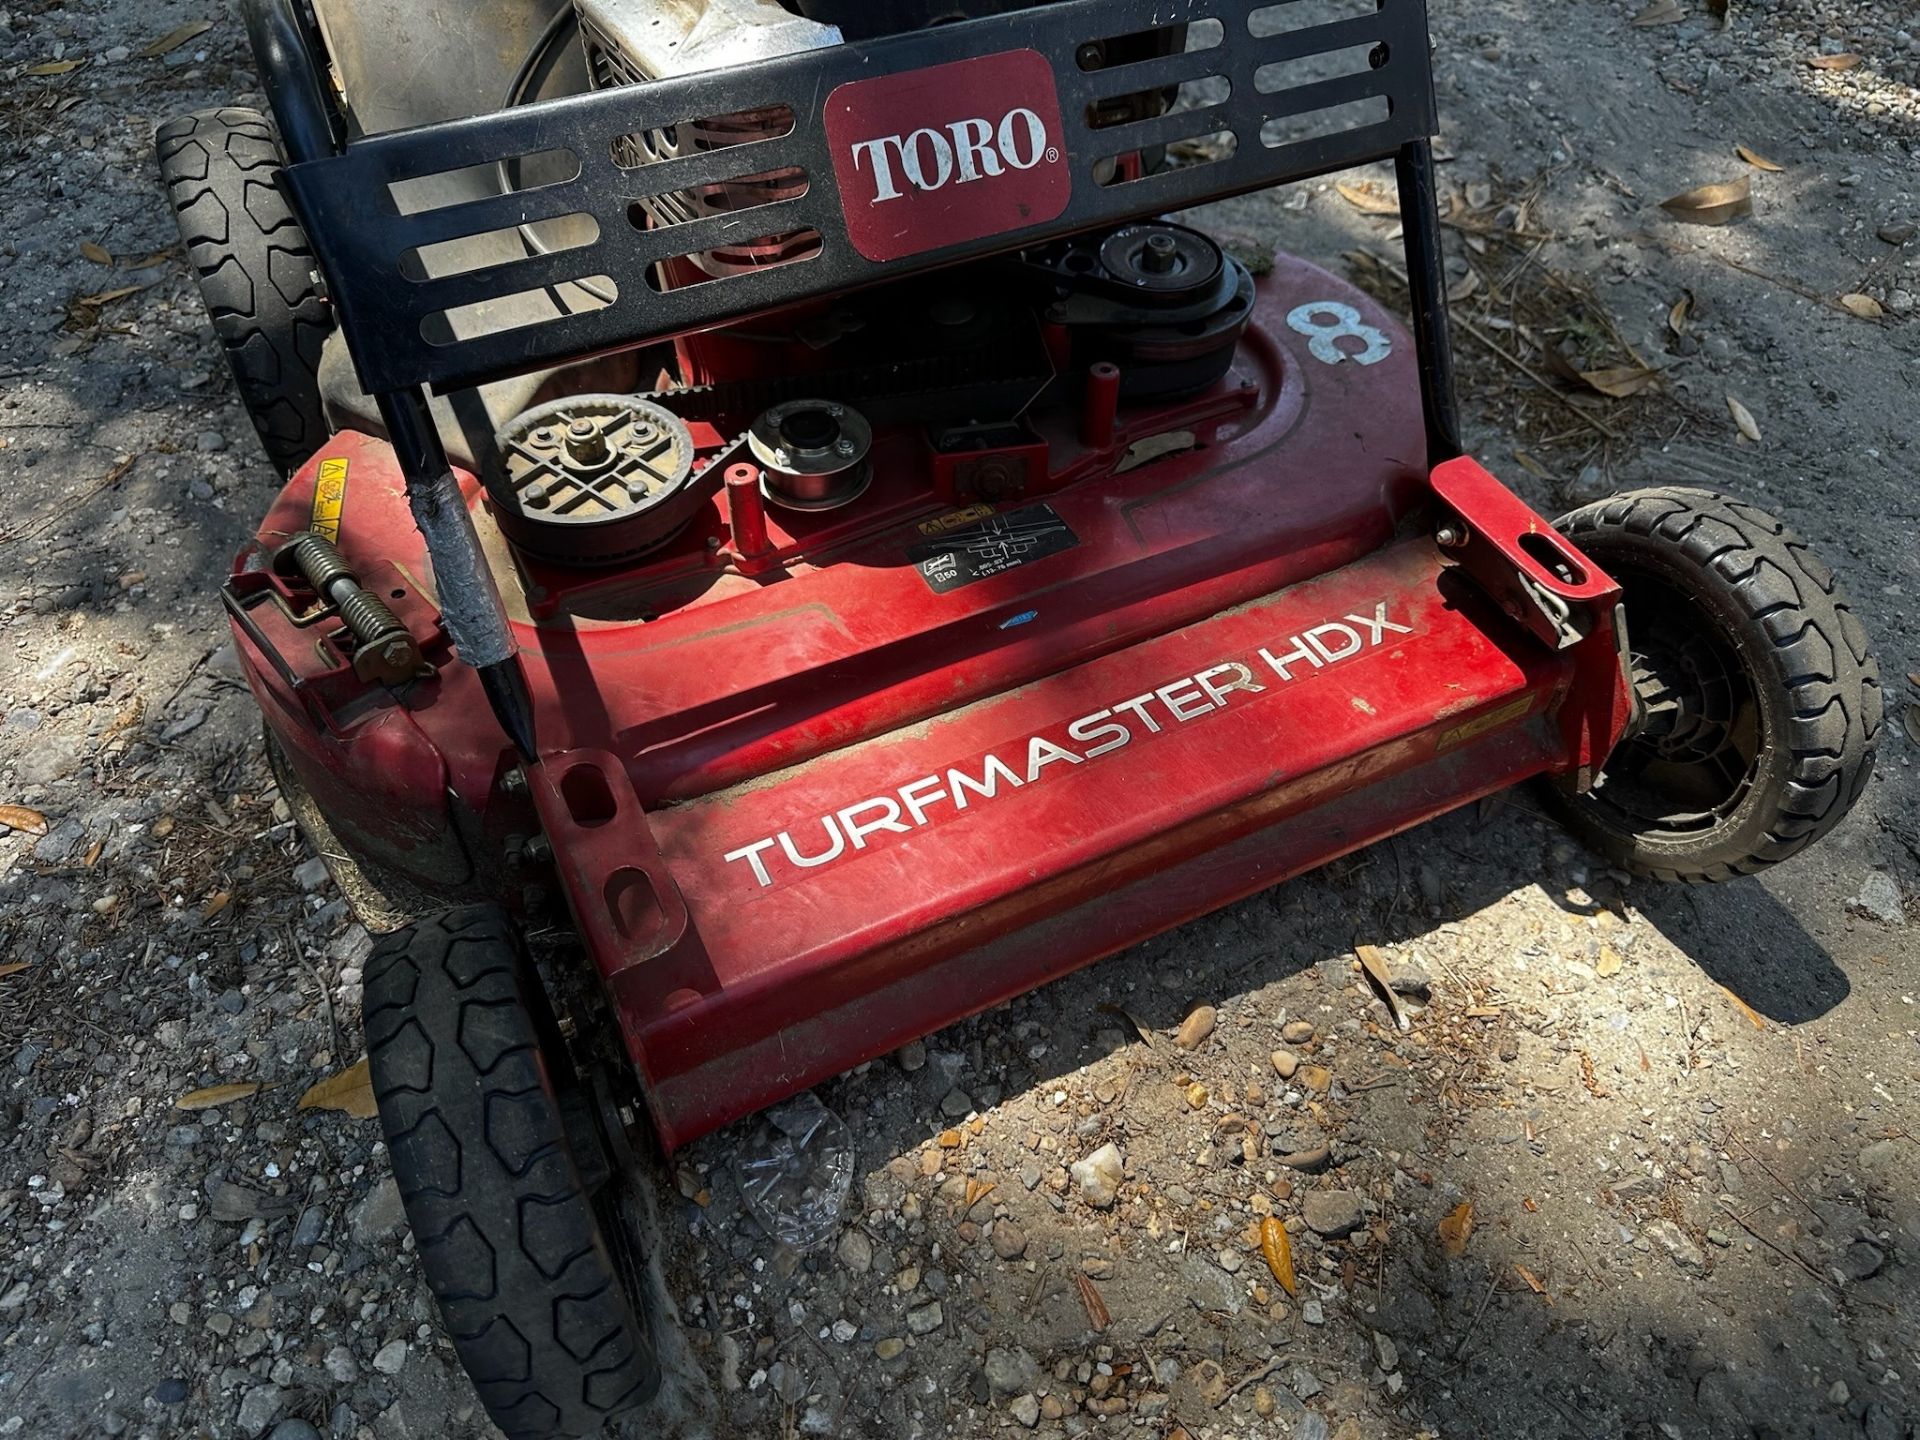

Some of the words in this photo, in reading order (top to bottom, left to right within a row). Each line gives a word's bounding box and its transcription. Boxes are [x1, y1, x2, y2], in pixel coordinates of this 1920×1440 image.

[1286, 300, 1392, 366] 8
[943, 569, 957, 579] 50
[724, 661, 1266, 887] TURFMASTER
[1259, 601, 1414, 681] HDX
